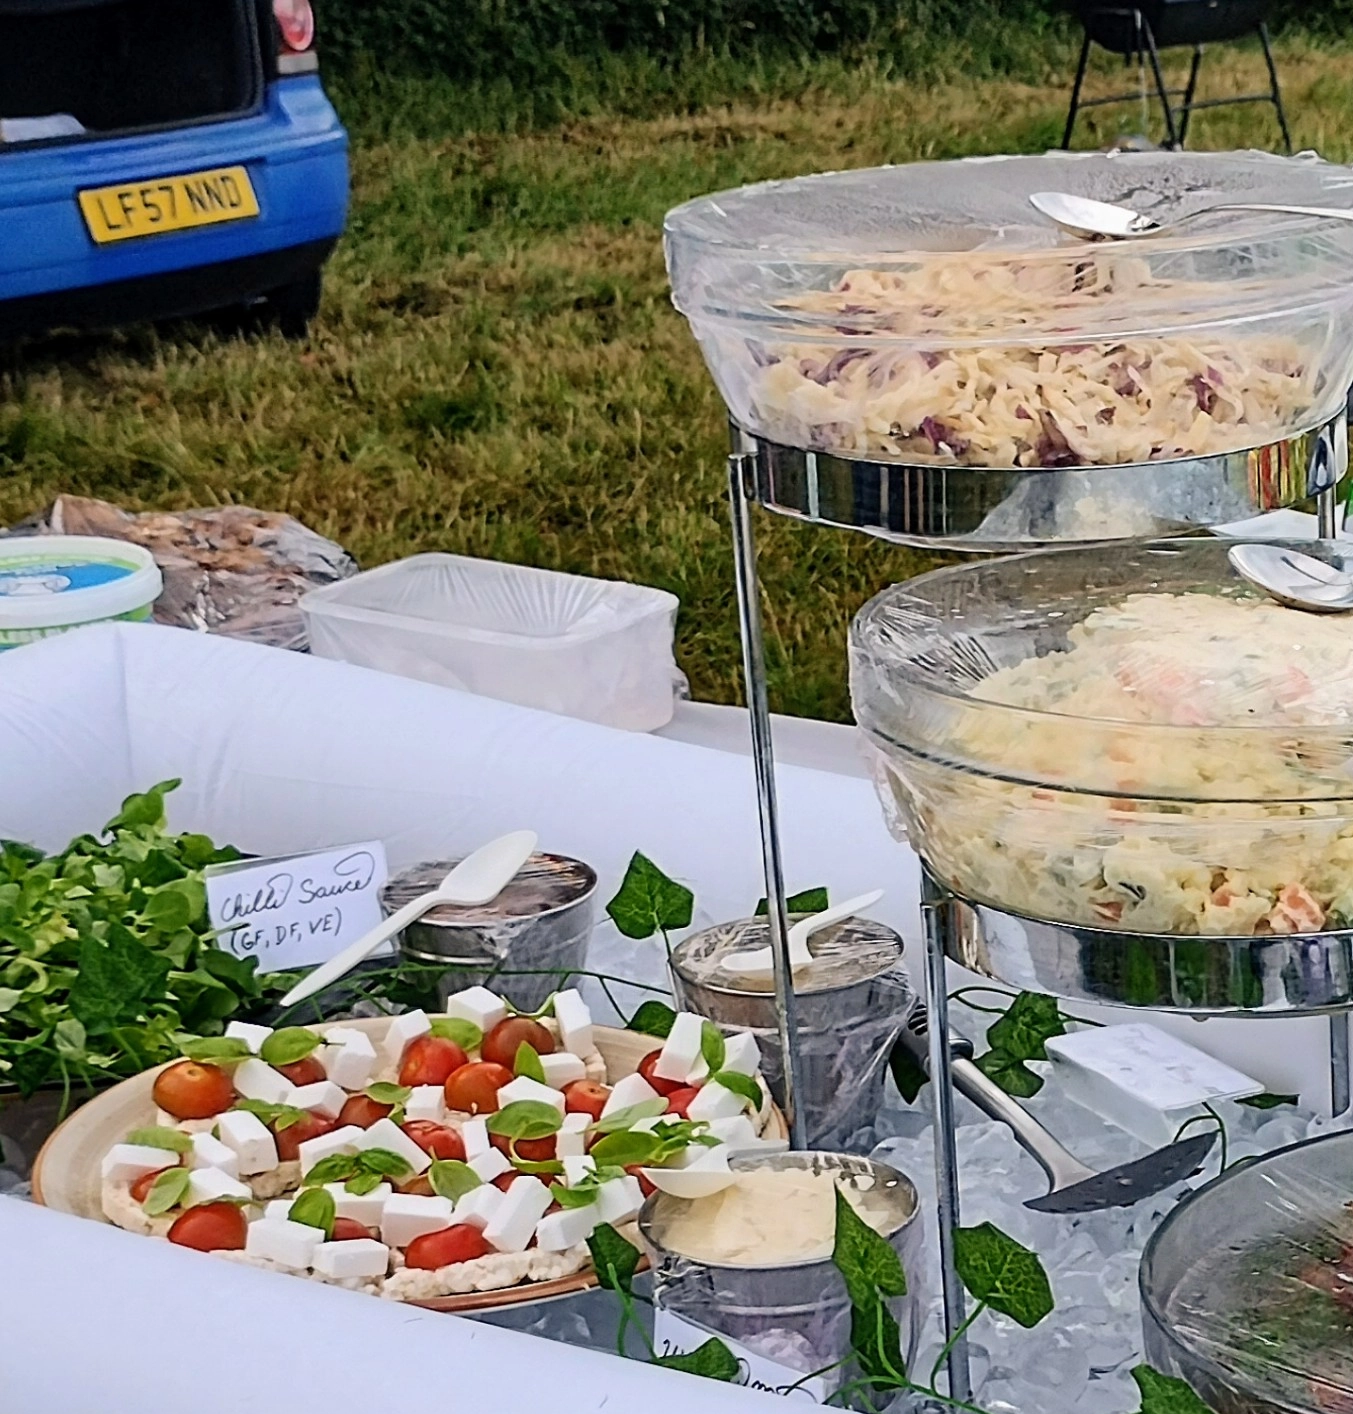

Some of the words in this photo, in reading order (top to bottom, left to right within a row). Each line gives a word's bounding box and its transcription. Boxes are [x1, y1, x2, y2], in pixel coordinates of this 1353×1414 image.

[96, 184, 177, 231] LF57
[220, 872, 294, 923] Chilli
[298, 850, 376, 904] Sauce
